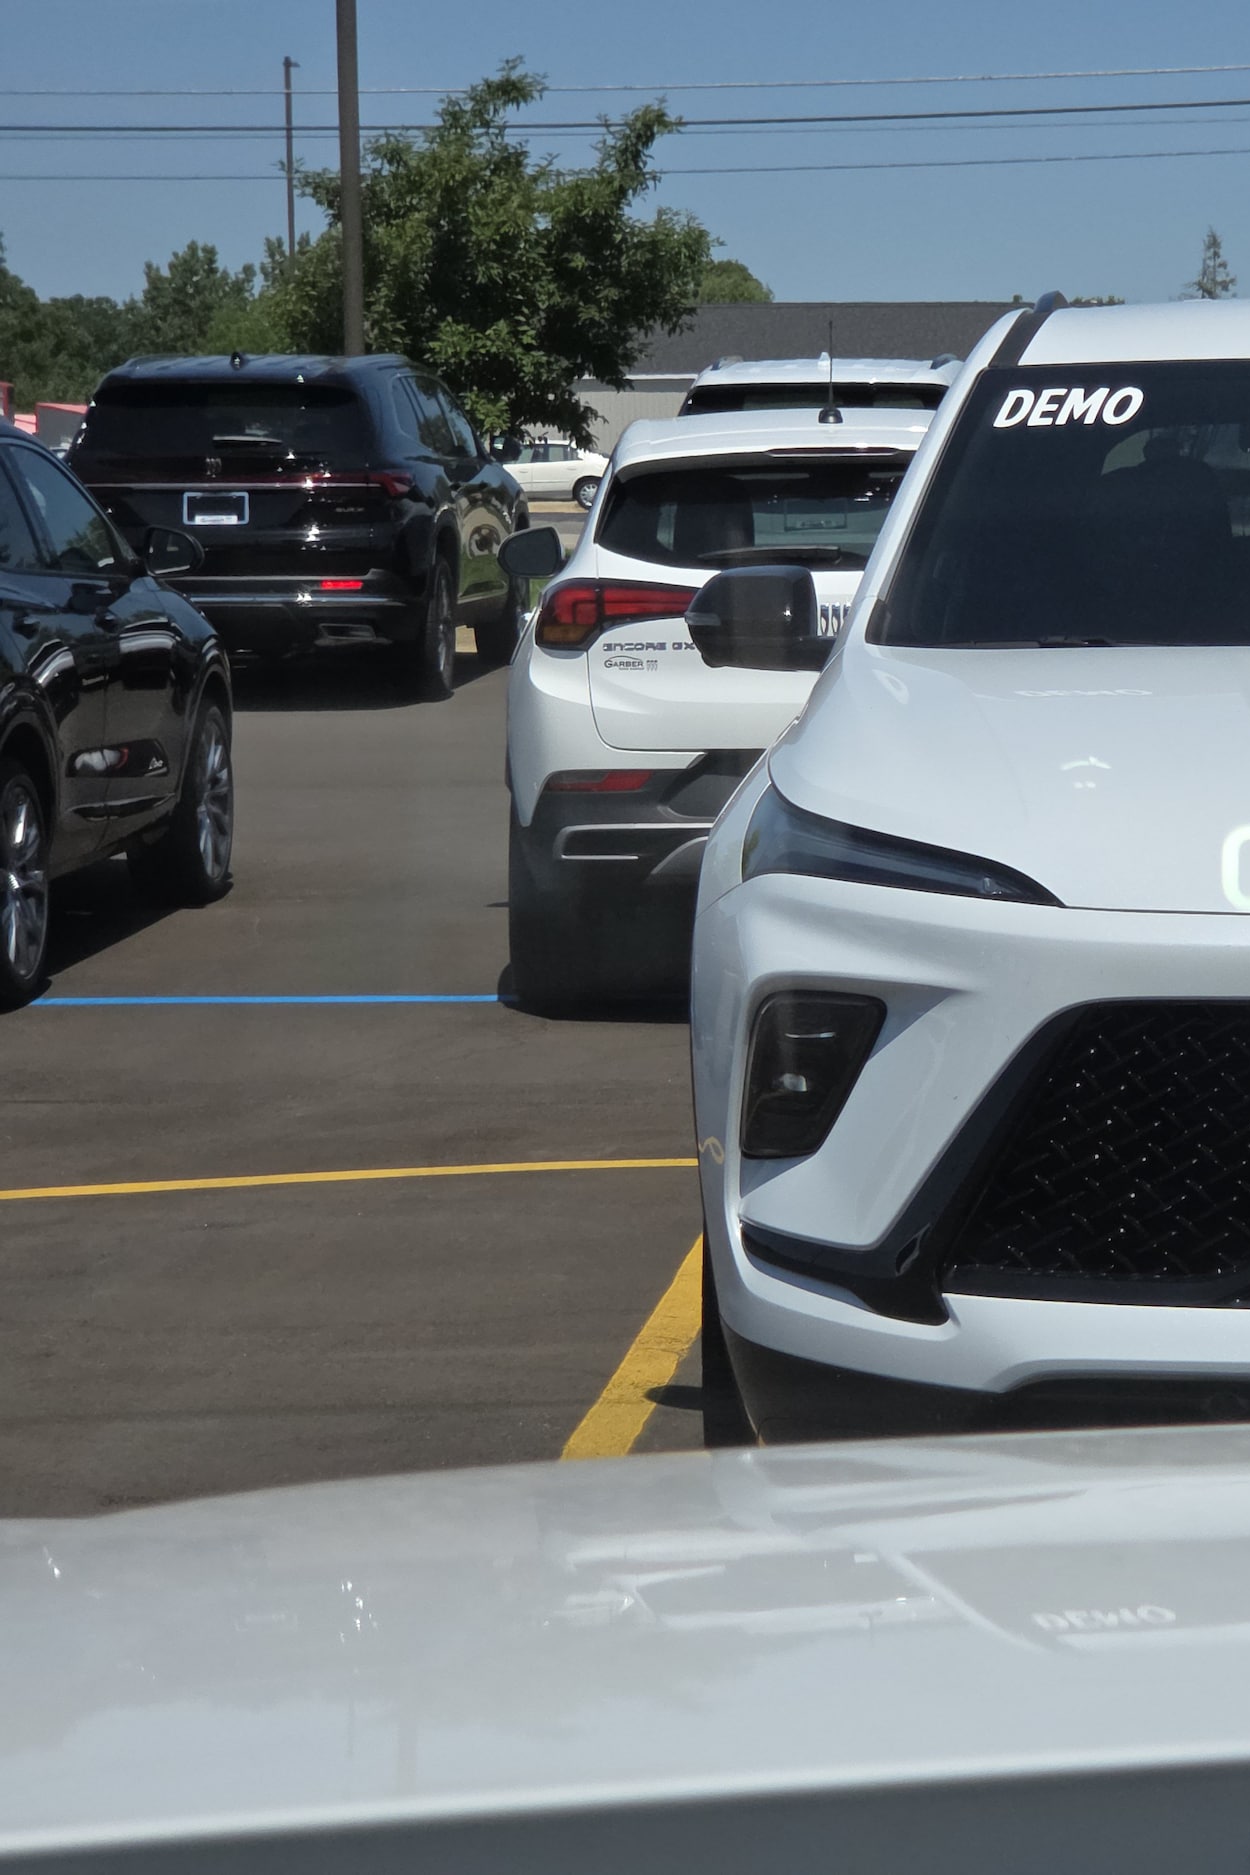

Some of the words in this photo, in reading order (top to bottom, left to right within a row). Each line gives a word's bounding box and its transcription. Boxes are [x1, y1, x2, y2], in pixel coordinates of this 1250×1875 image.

[992, 386, 1145, 428] DEMO
[602, 642, 667, 652] ENCORE
[603, 659, 643, 668] GARBER
